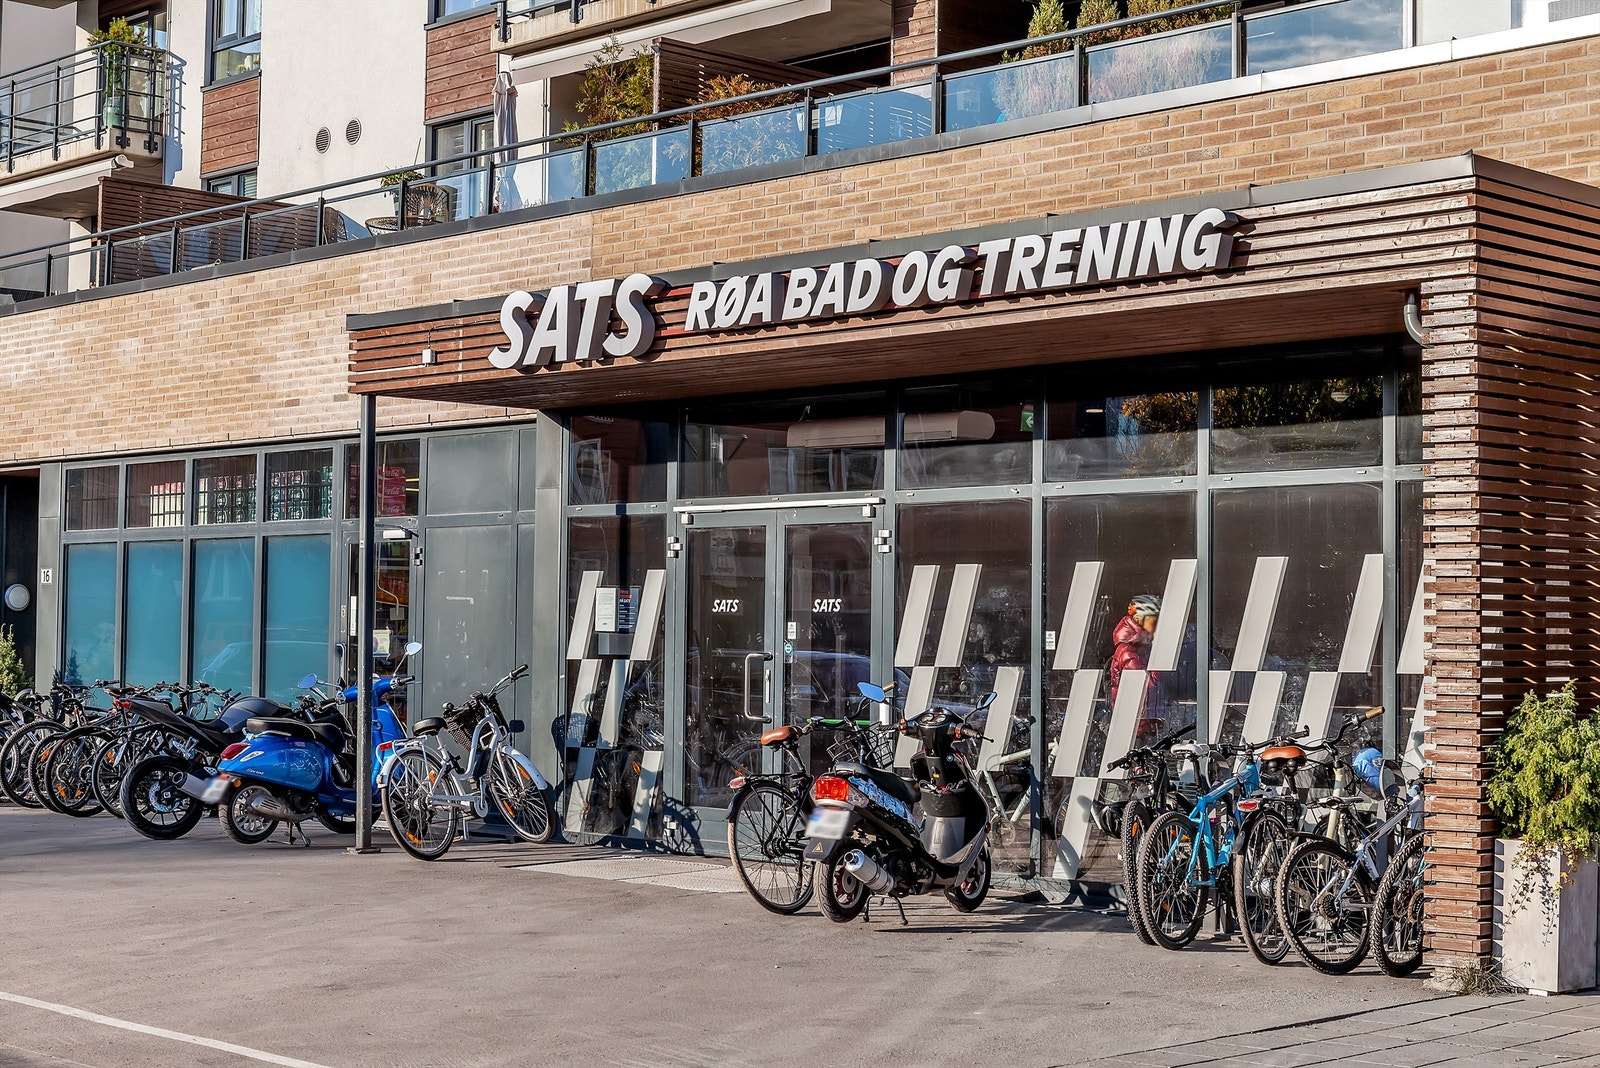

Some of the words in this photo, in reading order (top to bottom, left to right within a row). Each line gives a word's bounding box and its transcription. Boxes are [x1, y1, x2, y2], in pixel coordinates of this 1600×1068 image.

[488, 273, 656, 370] SATS
[684, 272, 774, 331] RØA
[782, 258, 884, 320] BAD
[892, 245, 968, 306] OG
[978, 208, 1228, 297] TRENING
[43, 571, 50, 582] 16
[712, 599, 740, 613] SATS
[812, 598, 842, 613] SATS
